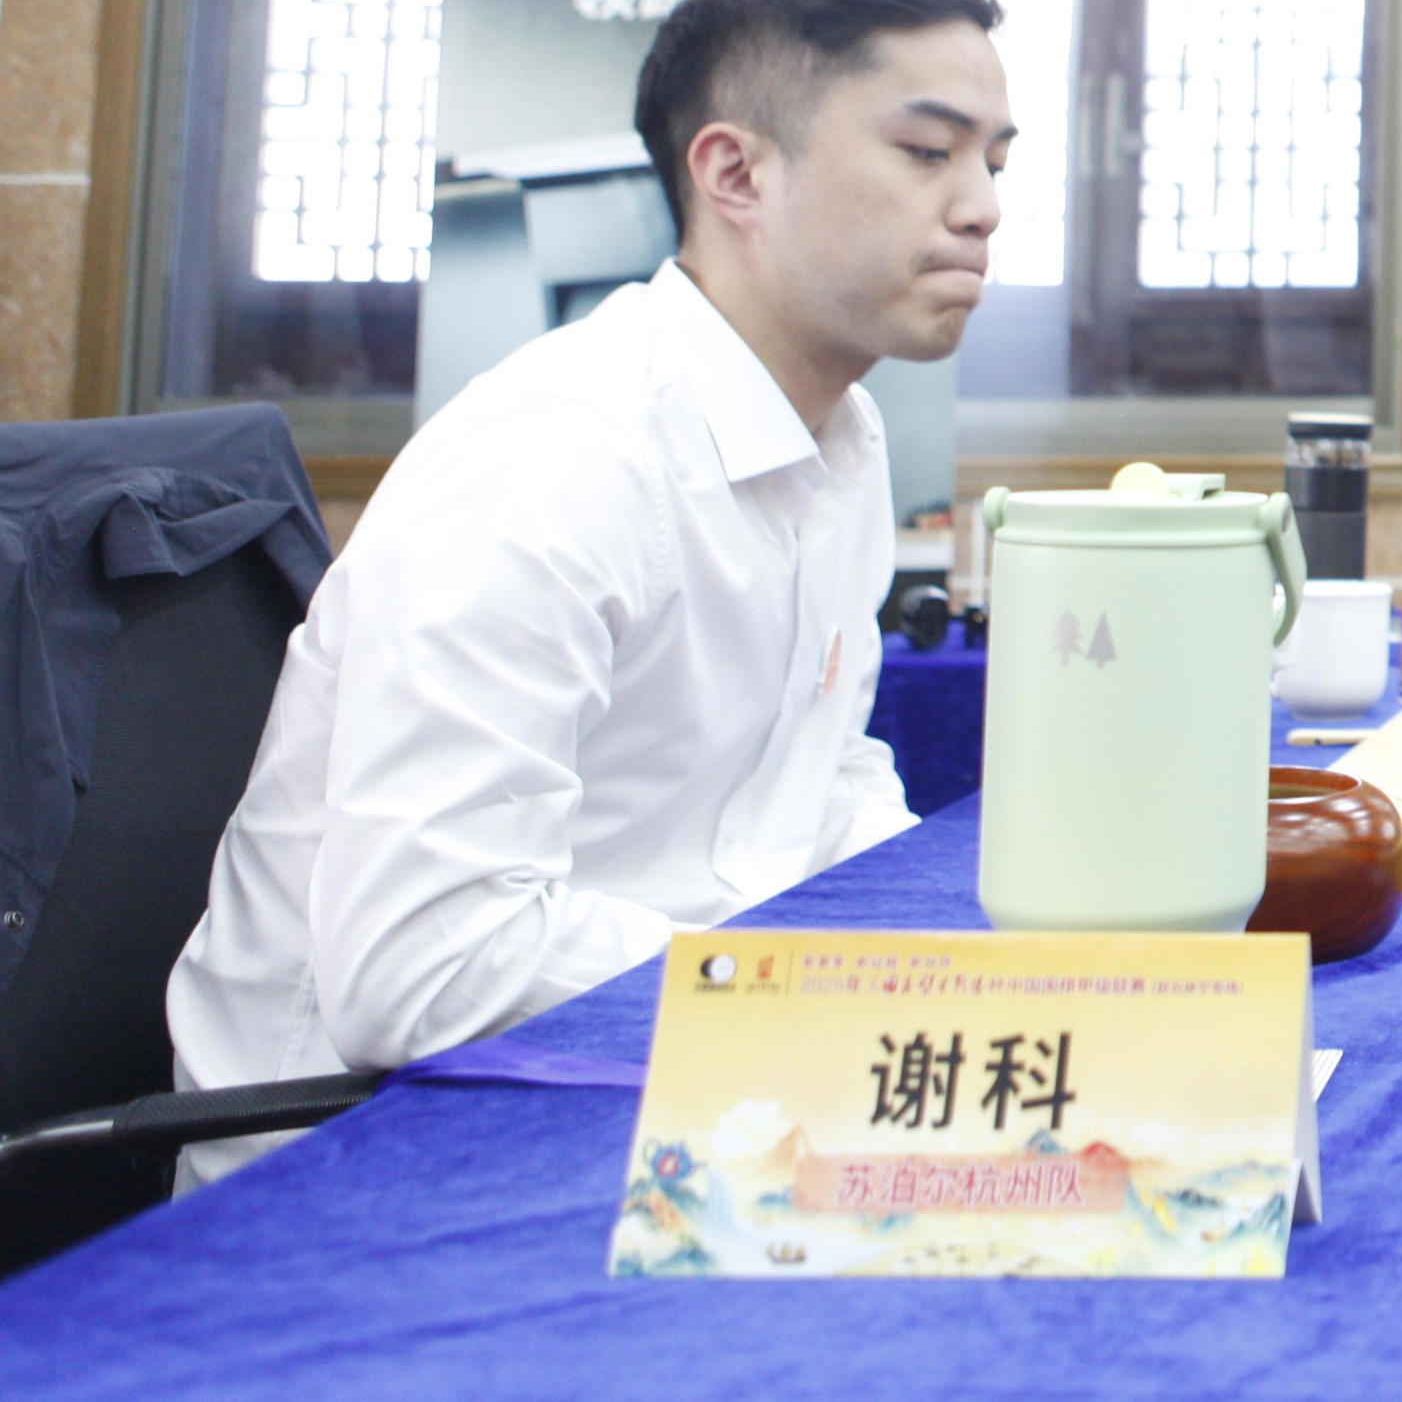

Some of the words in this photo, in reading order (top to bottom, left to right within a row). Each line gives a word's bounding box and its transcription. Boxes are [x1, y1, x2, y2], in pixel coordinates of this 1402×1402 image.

[869, 1031, 1076, 1131] 谢科
[838, 1164, 1087, 1207] 苏泊尔杭州队
